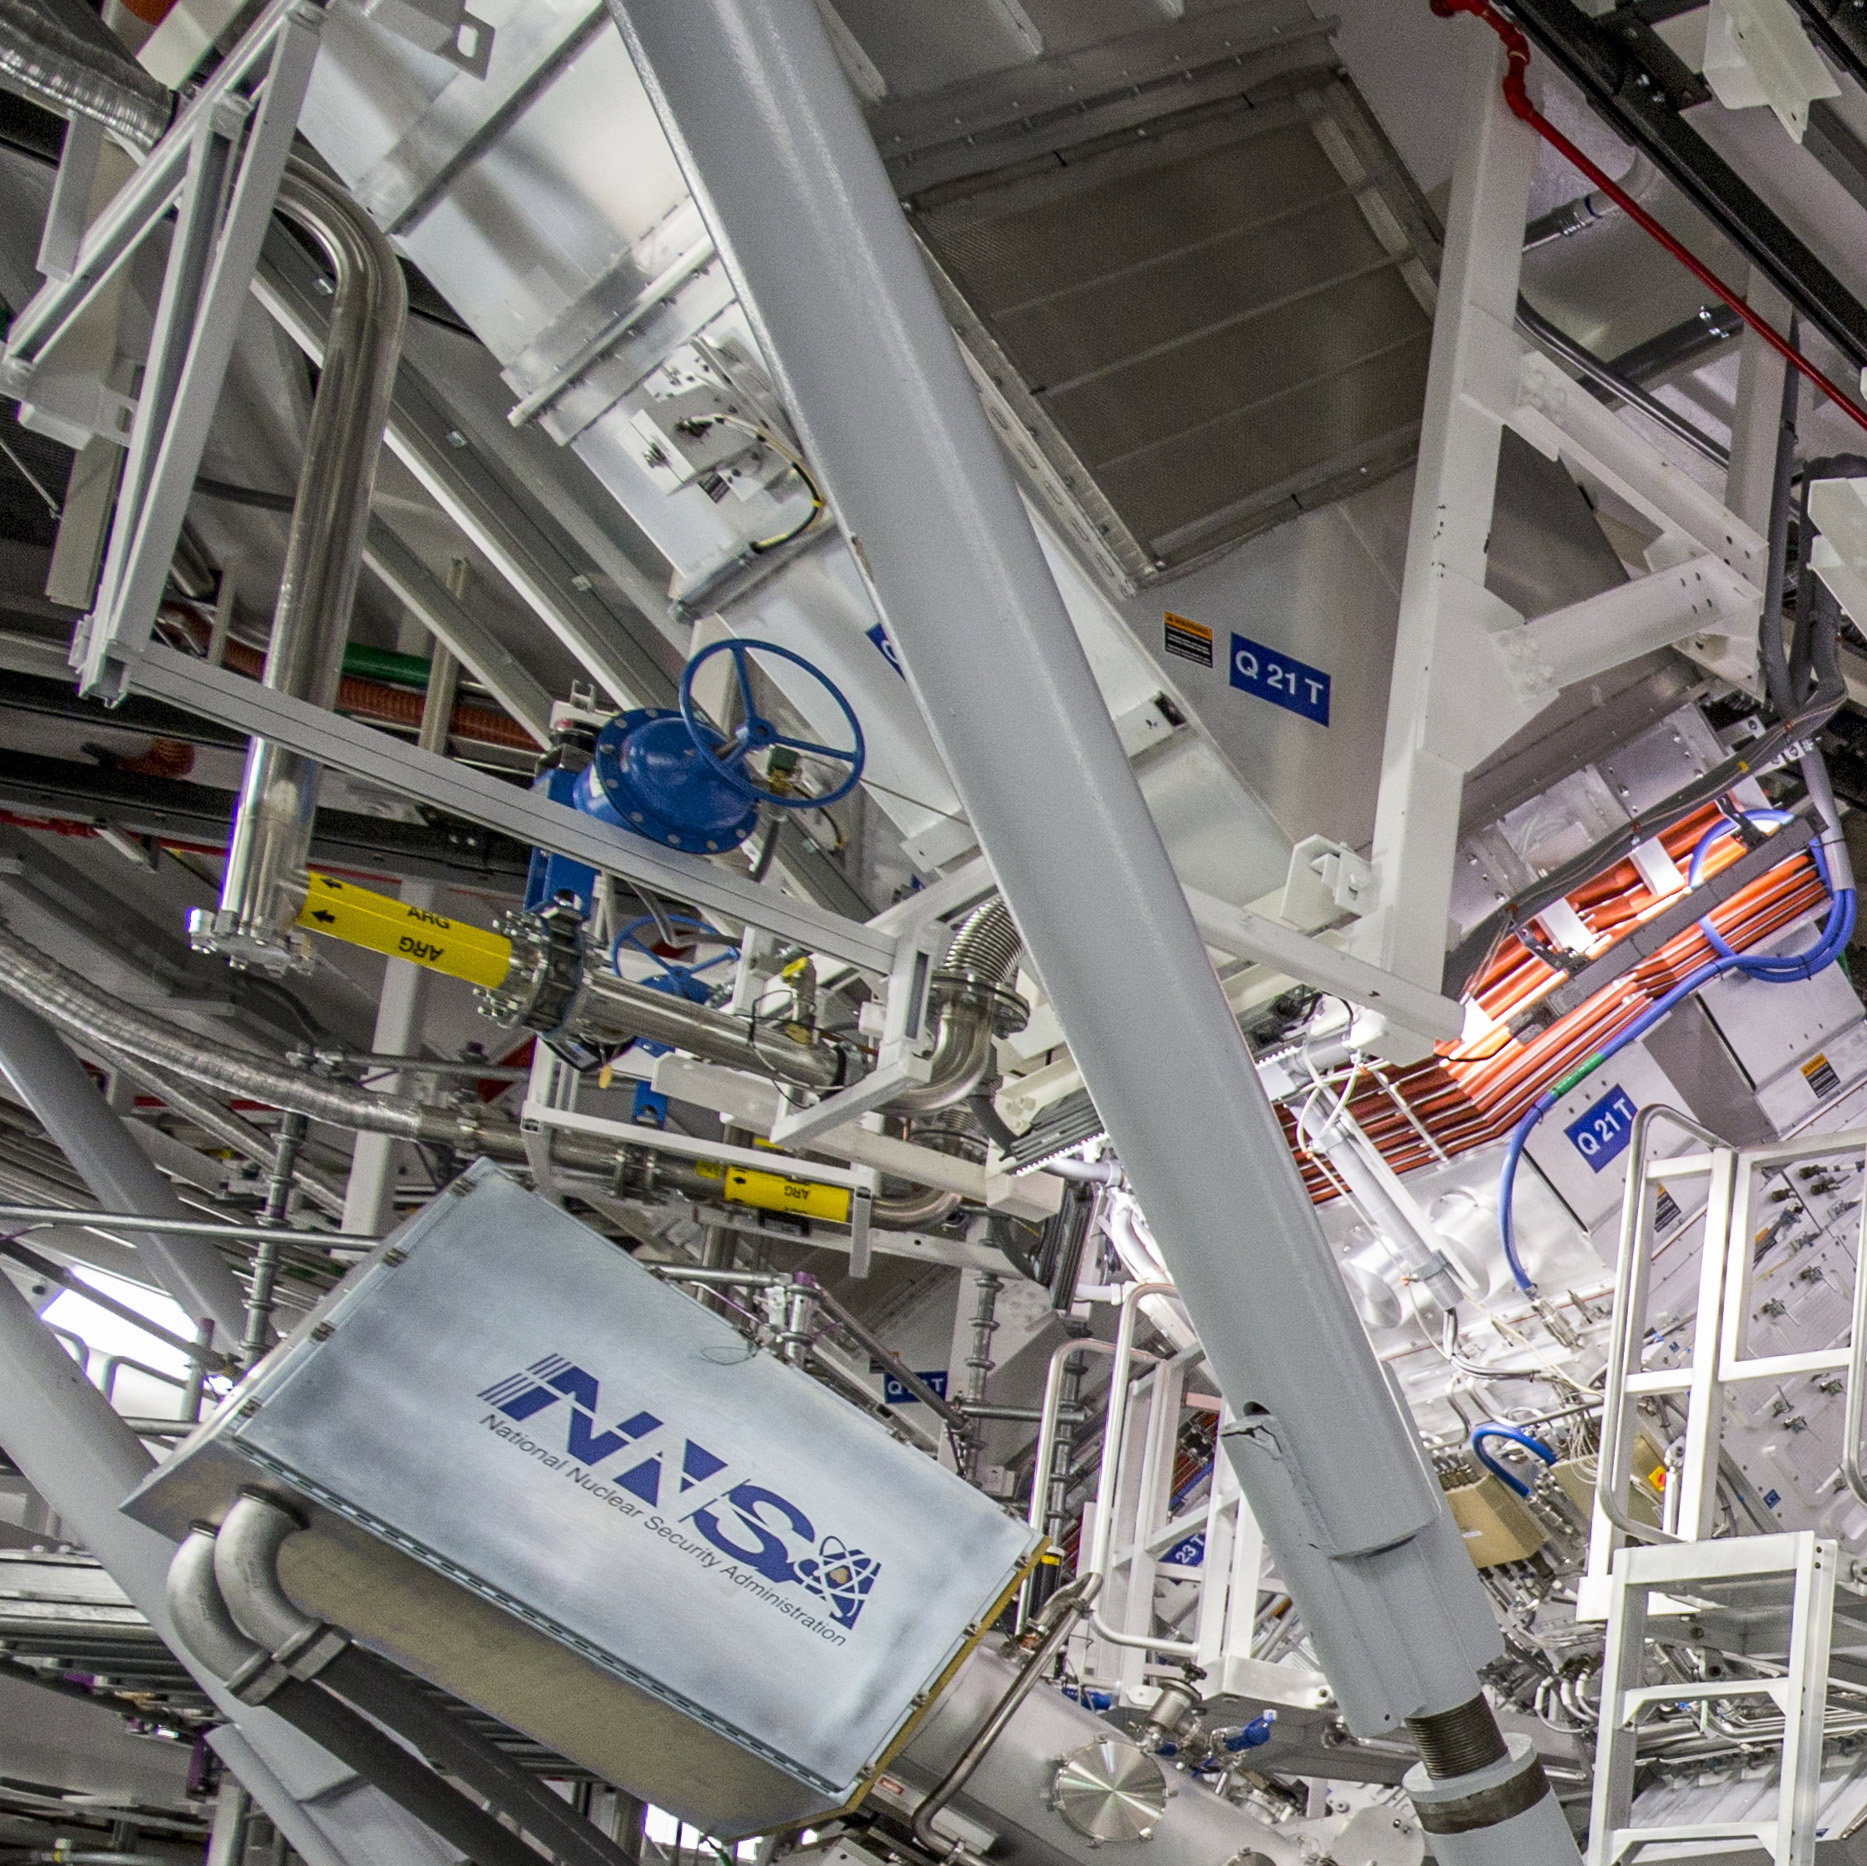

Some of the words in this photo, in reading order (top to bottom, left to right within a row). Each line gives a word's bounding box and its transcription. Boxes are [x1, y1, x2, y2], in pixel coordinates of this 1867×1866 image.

[1235, 649, 1259, 680] Q
[1266, 663, 1297, 696] 21
[1304, 677, 1325, 705] T
[398, 934, 446, 964] ARG
[1576, 1131, 1602, 1157] Q
[1595, 1110, 1620, 1143] 21
[1613, 1097, 1634, 1122] T
[783, 1184, 811, 1201] ARG
[887, 1380, 903, 1396] Q
[930, 1377, 945, 1393] T
[479, 1412, 570, 1472] National
[565, 1466, 655, 1519] Nuclear
[643, 1515, 723, 1570] Security
[719, 1561, 848, 1648] Administration
[1174, 1544, 1198, 1565] 23
